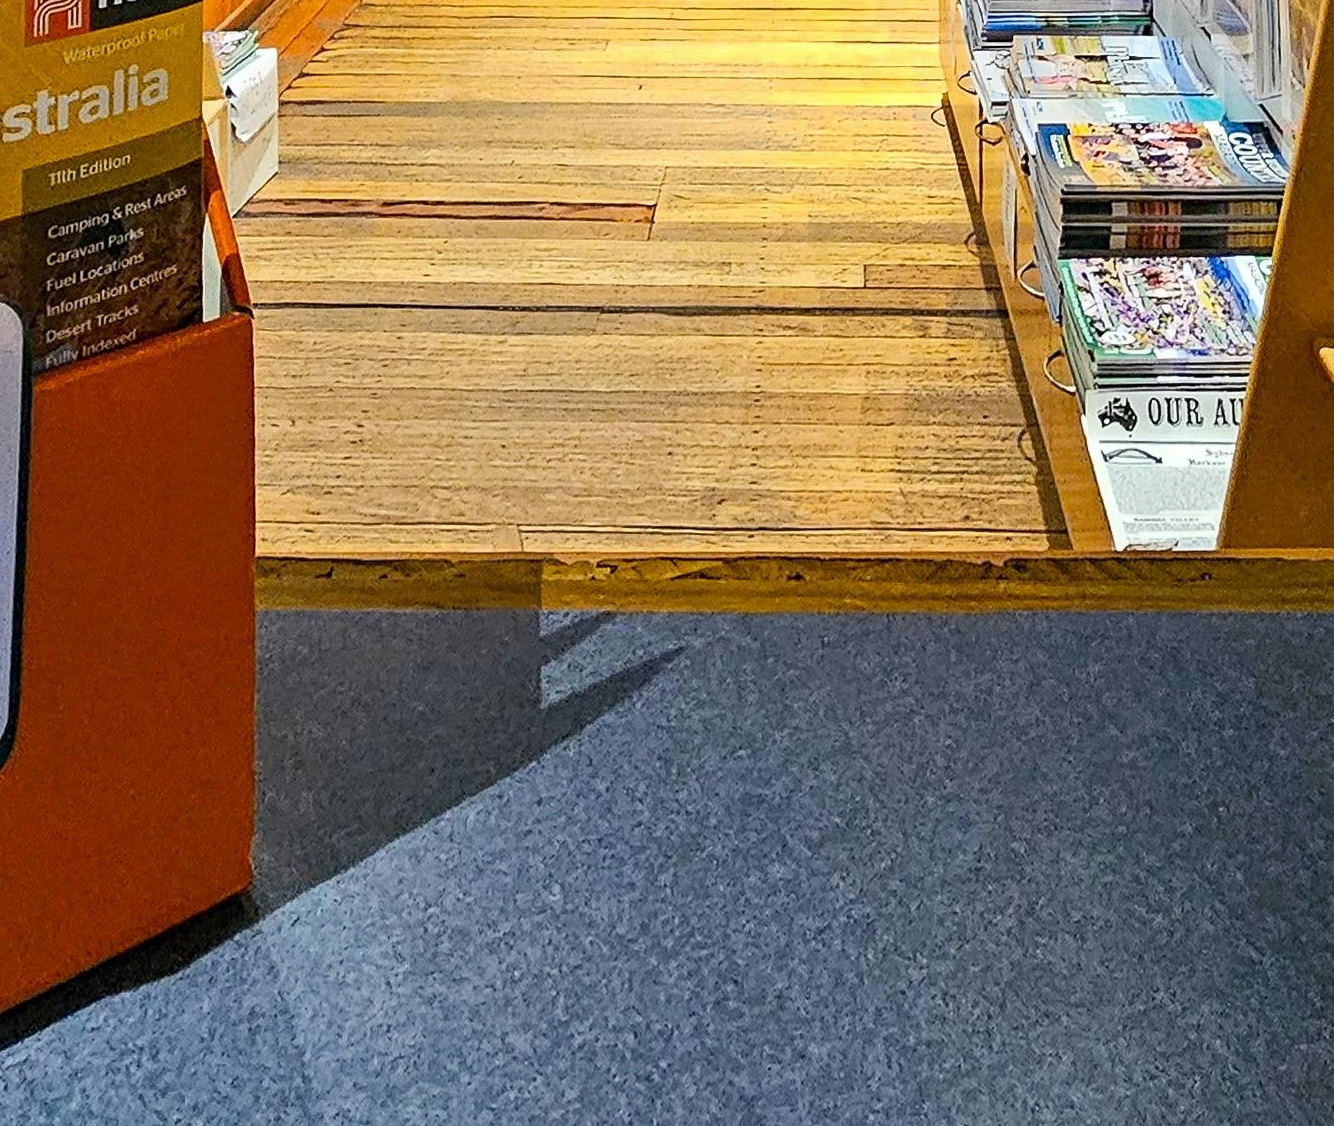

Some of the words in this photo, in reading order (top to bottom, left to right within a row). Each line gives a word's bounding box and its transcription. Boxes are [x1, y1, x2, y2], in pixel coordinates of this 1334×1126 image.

[80, 154, 132, 179] Edition
[47, 210, 110, 240] Camping
[112, 206, 123, 220] &
[125, 197, 153, 217] Rest
[153, 184, 188, 207] Areas
[46, 240, 105, 267] Caravan
[108, 226, 145, 249] Parks
[46, 274, 78, 293] Fuel
[80, 250, 146, 282] Locations
[46, 283, 129, 317] Information
[129, 263, 179, 291] Centres
[45, 320, 92, 345] Desert
[96, 303, 140, 327] Tracks
[82, 327, 138, 357] Indexed
[1148, 397, 1205, 427] OUR
